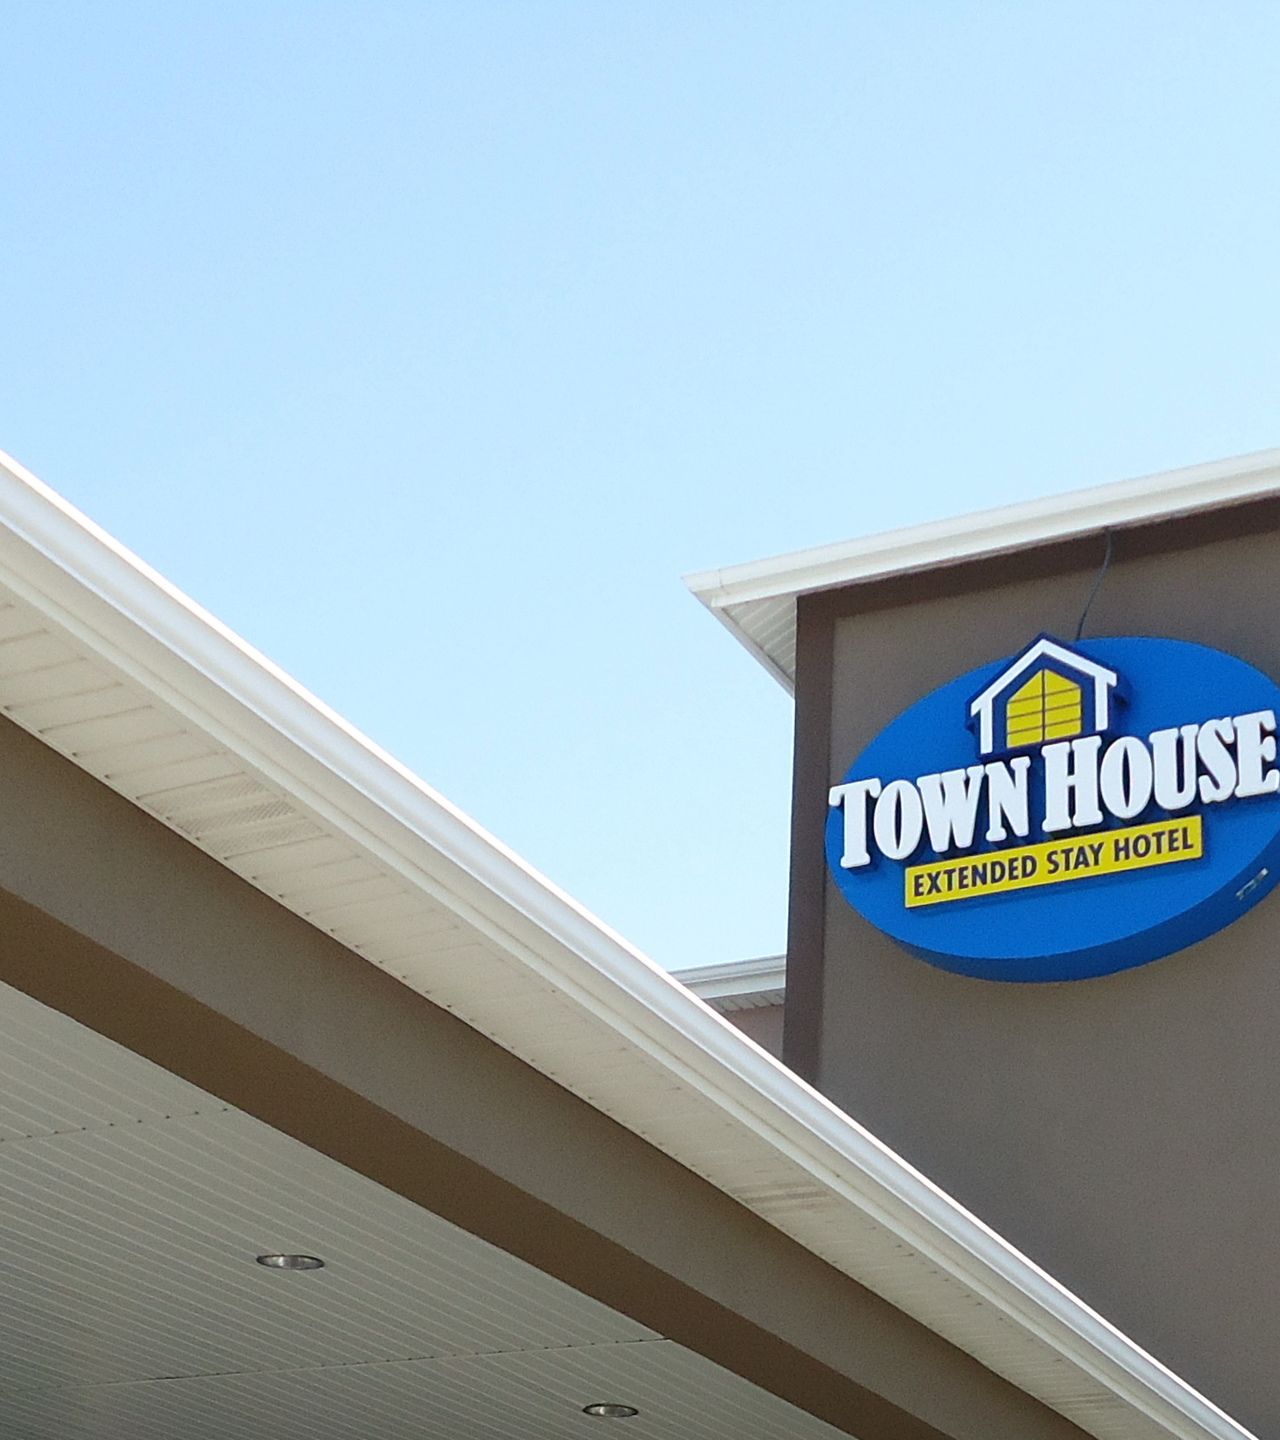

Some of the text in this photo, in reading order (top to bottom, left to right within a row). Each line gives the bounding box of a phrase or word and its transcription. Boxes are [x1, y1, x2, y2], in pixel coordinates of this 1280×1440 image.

[829, 709, 1280, 869] TOWN HOUSE
[913, 826, 1194, 897] EXTENDED STAY HOTEL
